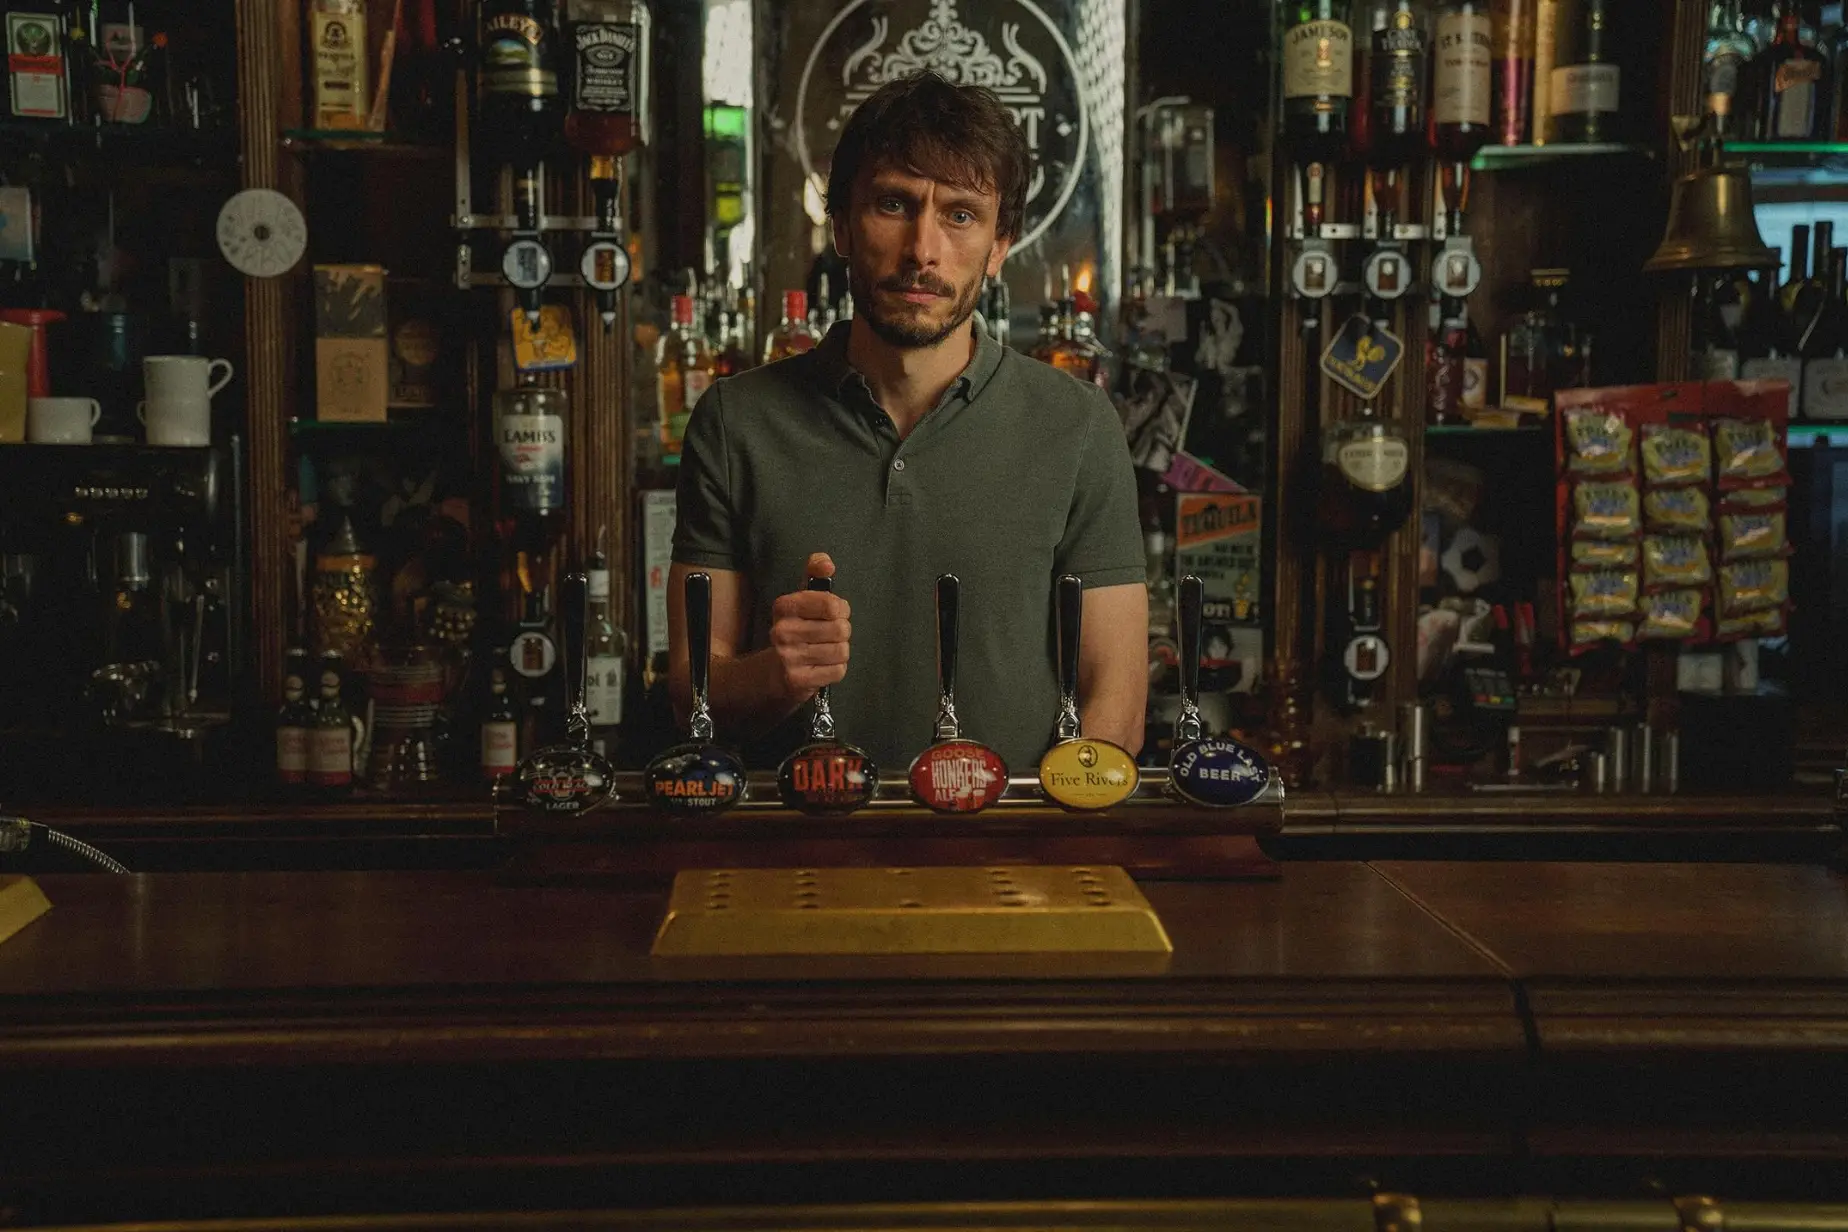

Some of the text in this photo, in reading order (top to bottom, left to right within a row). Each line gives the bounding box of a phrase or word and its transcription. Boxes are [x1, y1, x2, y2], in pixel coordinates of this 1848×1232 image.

[931, 748, 986, 760] GOOSE
[1180, 742, 1261, 783] OLD BLUE LAST
[792, 758, 864, 793] DARK
[1051, 772, 1080, 786] Five
[1199, 767, 1241, 782] BEER
[654, 777, 707, 797] PEARL
[546, 801, 580, 811] LAGER
[687, 797, 717, 807] STOUT
